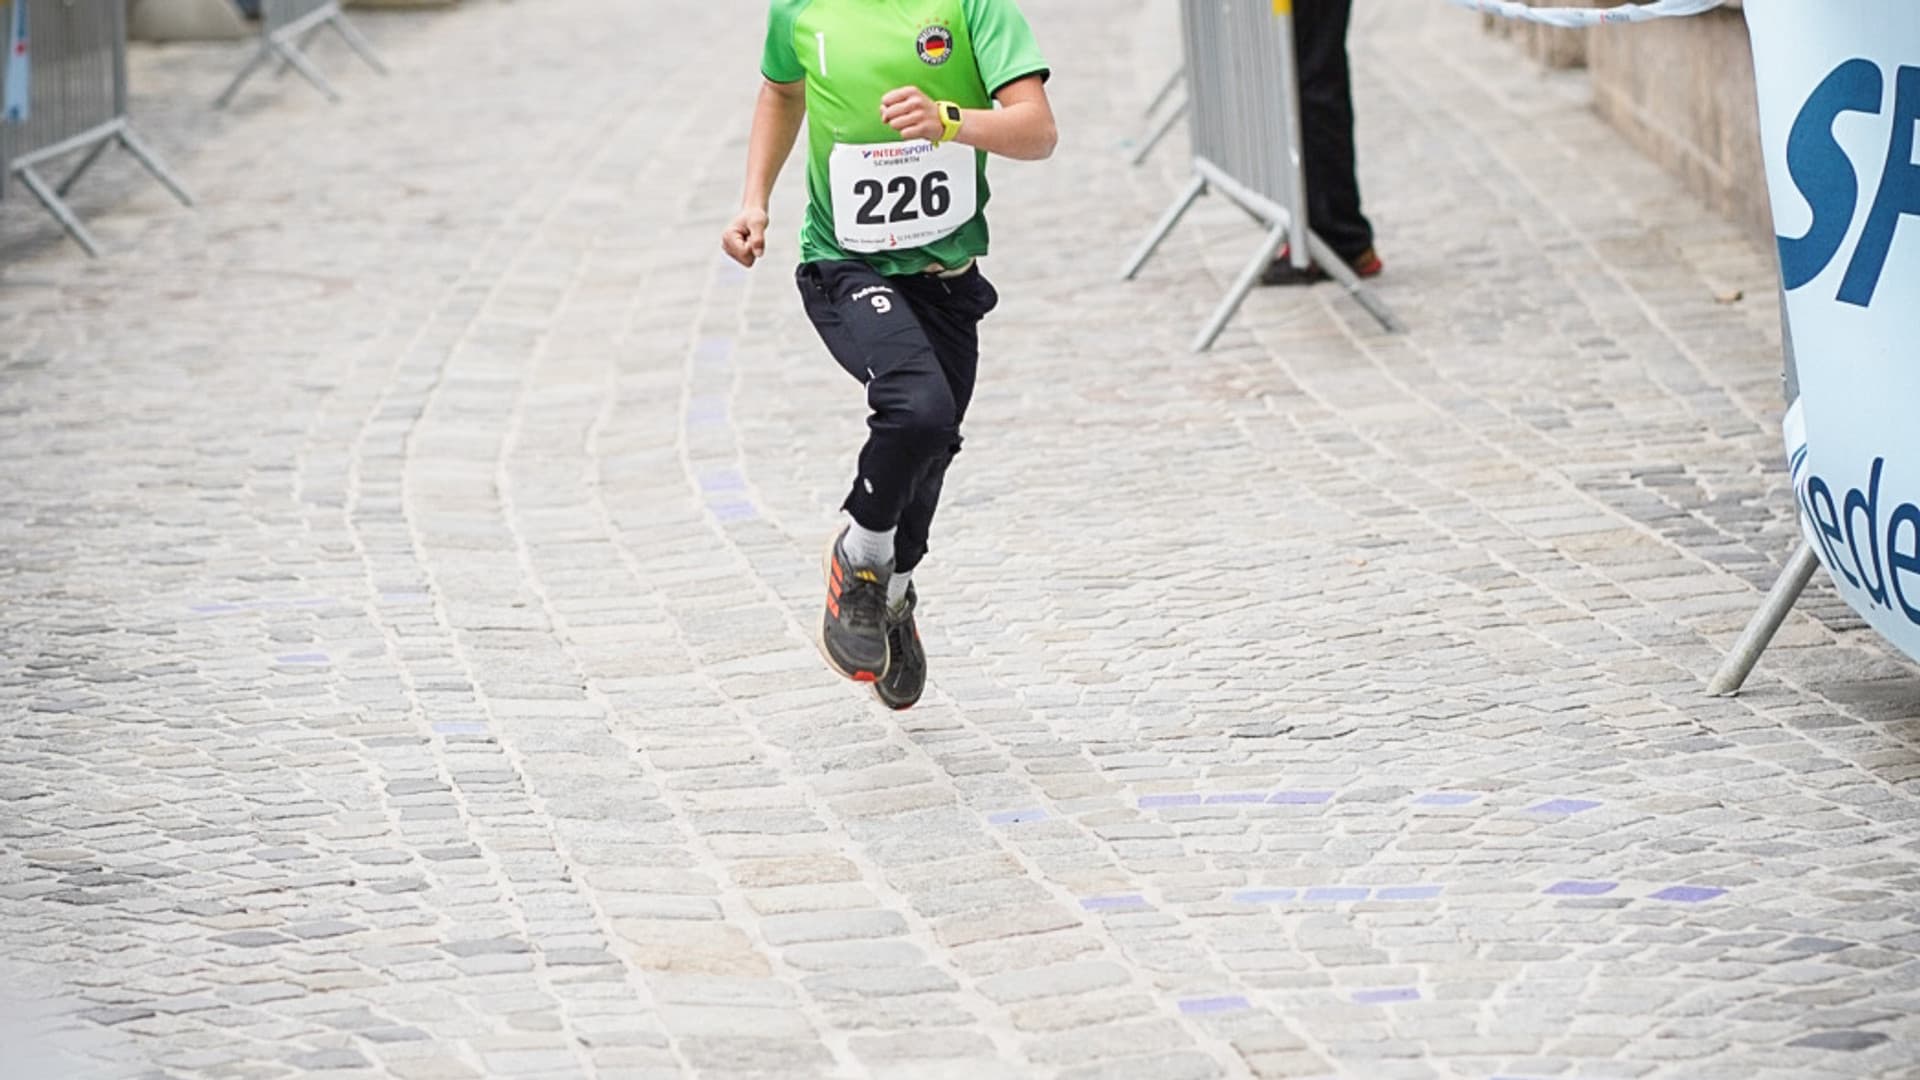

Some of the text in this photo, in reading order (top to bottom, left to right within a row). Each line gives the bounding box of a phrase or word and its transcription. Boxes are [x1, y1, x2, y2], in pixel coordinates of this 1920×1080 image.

[815, 31, 828, 77] 1
[873, 145, 934, 157] INTERSPORT
[854, 171, 950, 224] 226
[870, 295, 892, 314] 9
